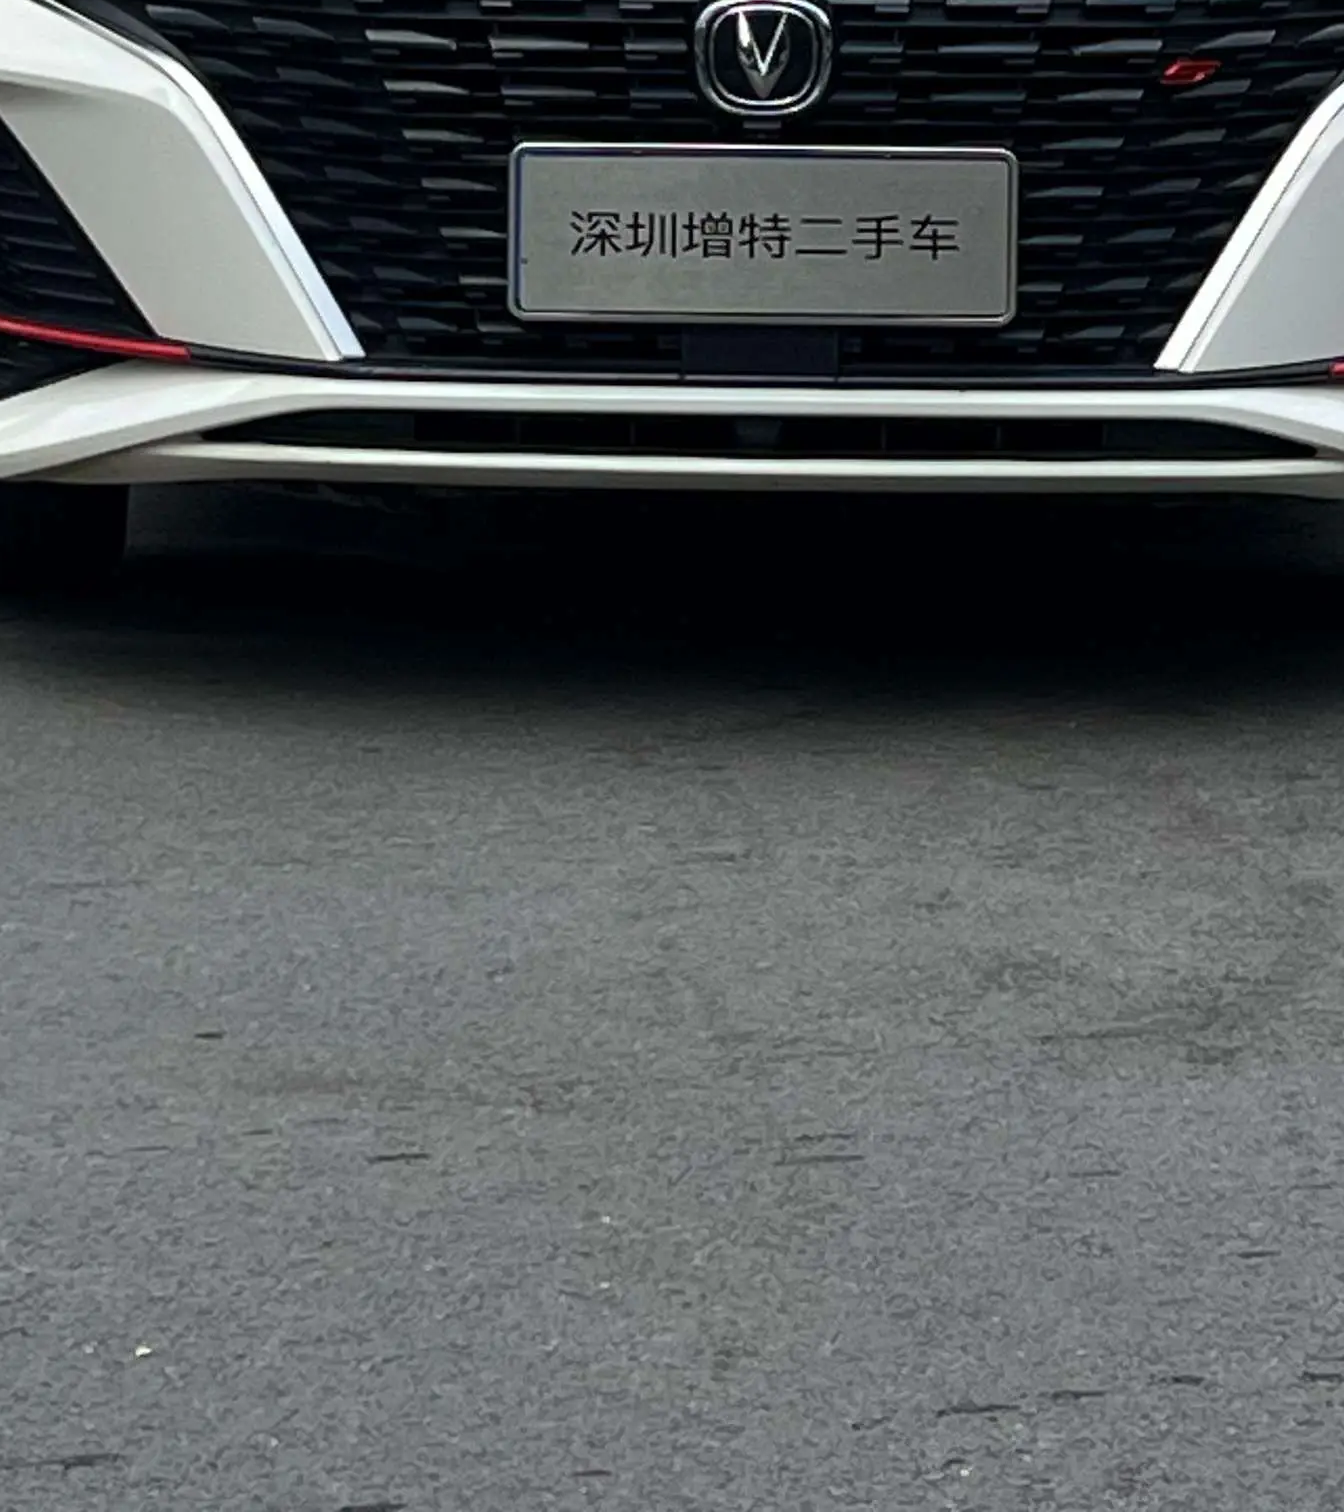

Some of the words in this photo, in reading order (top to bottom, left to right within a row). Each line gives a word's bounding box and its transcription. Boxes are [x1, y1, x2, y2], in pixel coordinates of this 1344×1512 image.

[570, 209, 962, 262] 深圳增特二手车
